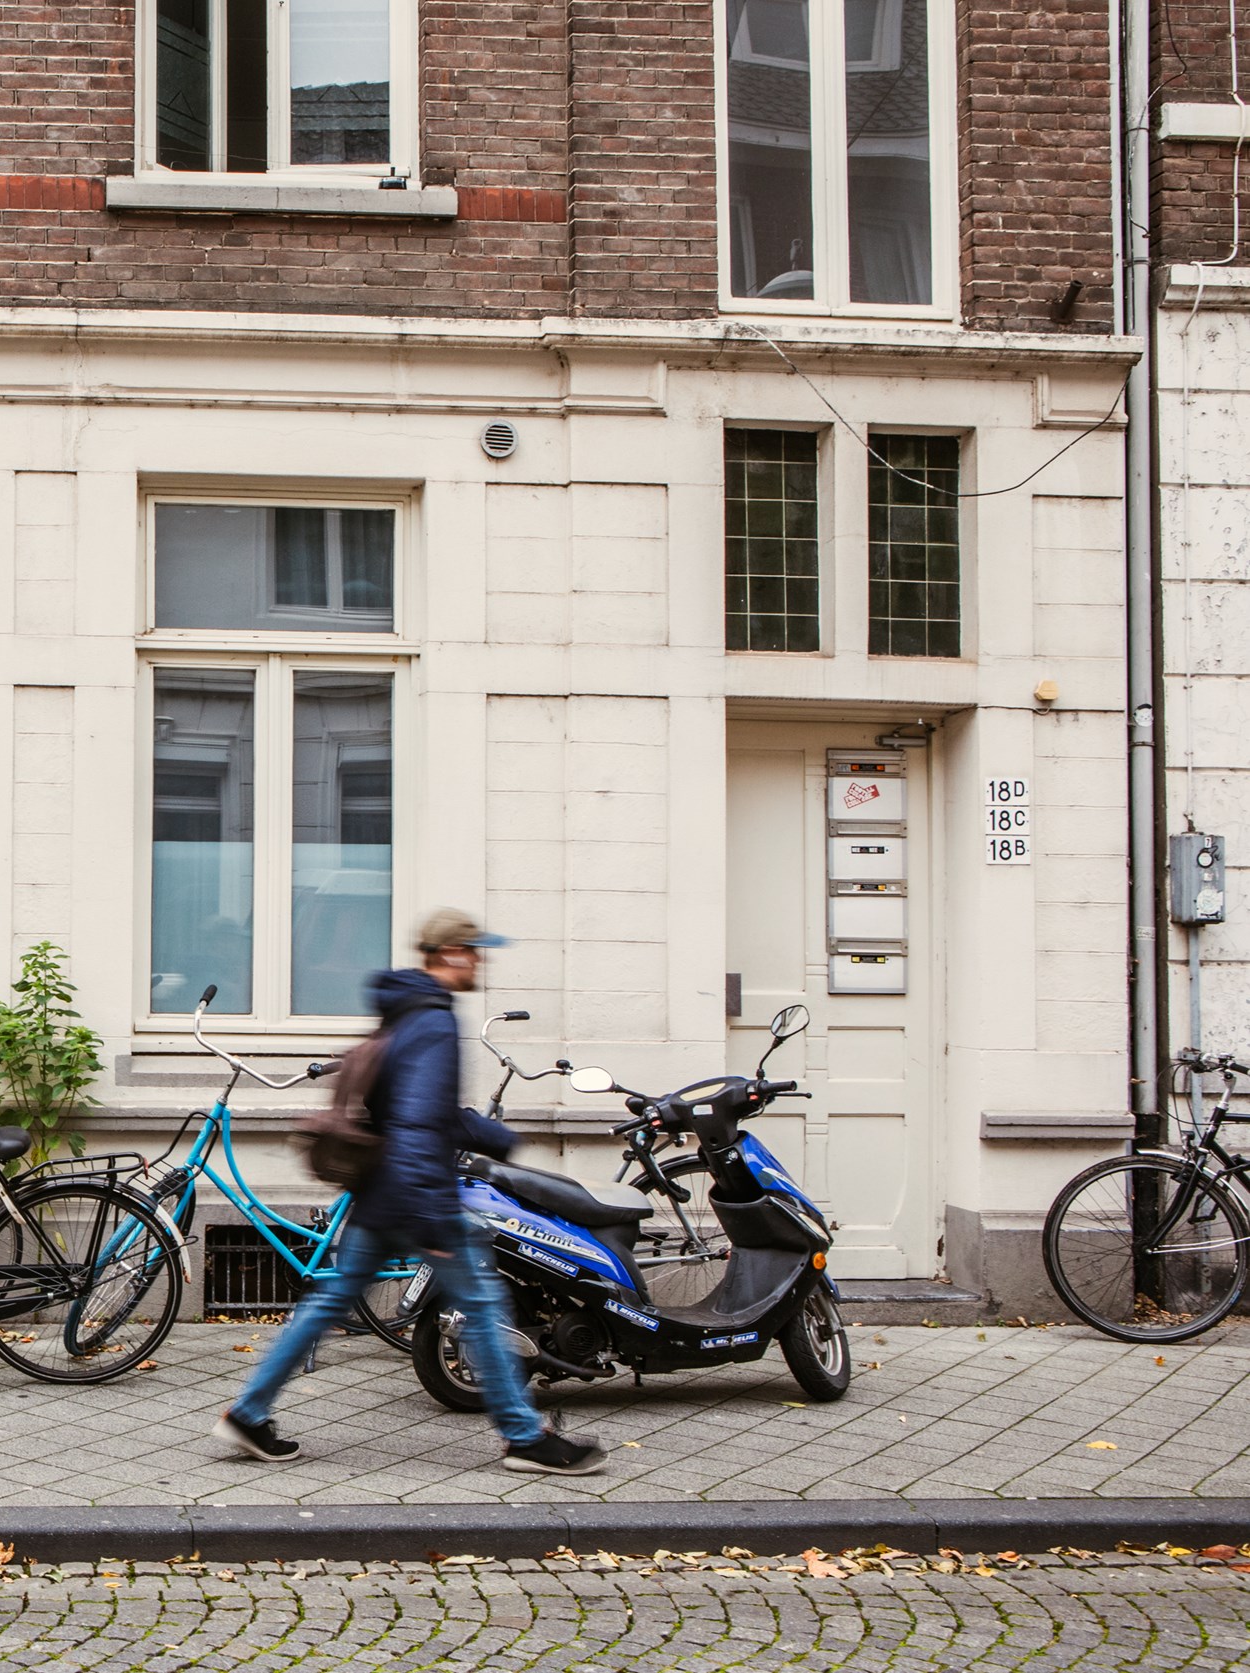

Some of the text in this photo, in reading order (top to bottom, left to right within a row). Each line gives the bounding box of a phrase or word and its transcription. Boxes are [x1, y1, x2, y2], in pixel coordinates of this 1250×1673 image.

[989, 780, 1025, 802] 18D
[989, 809, 1026, 831] 18C
[990, 839, 1027, 861] 18B
[506, 1218, 573, 1247] Off Limit
[533, 1251, 576, 1273] MICHELIN
